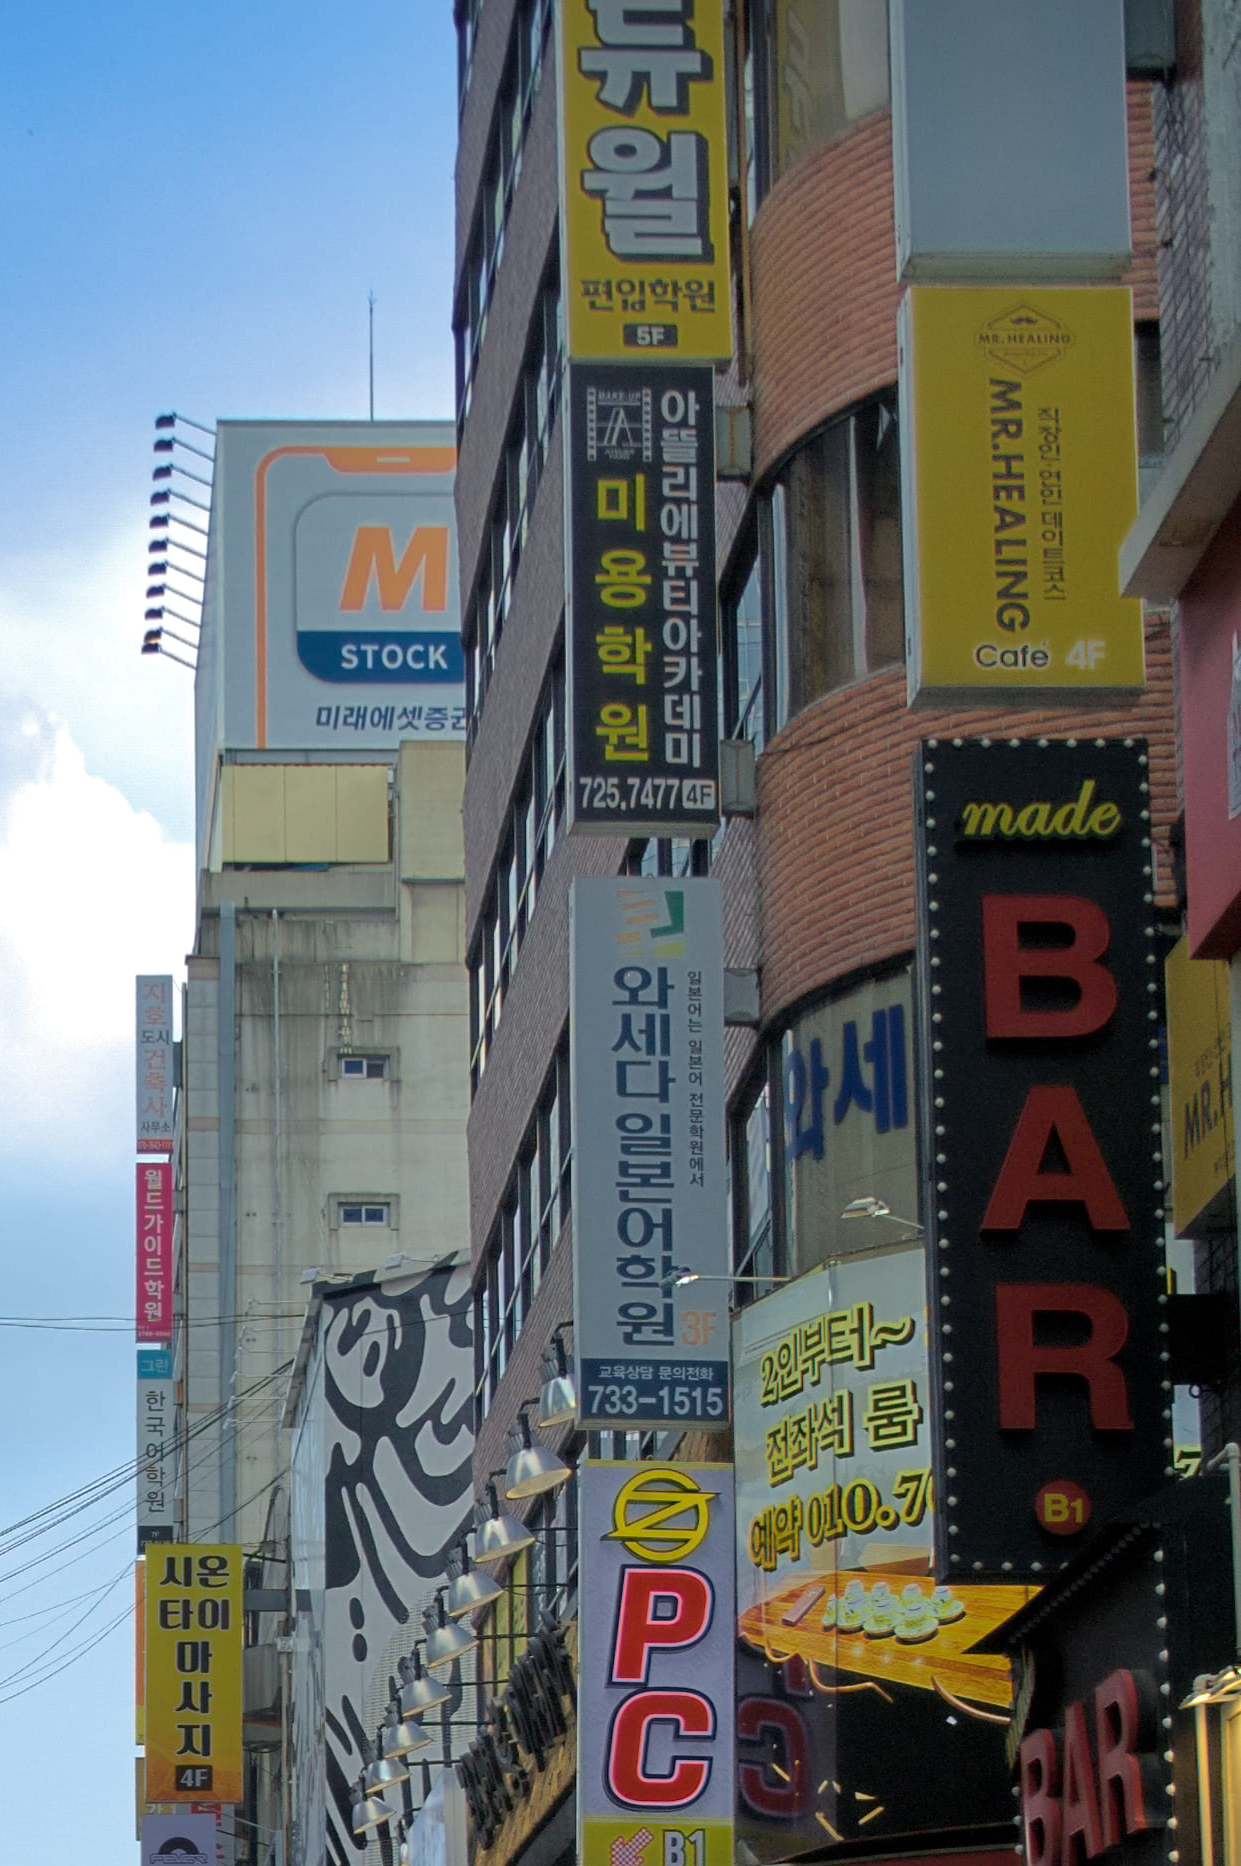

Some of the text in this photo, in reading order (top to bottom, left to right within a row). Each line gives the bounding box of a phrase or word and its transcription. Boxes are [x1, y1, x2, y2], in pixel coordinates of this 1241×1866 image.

[581, 279, 715, 313] 편입학원
[636, 326, 666, 346] 5F
[339, 525, 450, 613] M
[660, 389, 702, 768] 아뜰리에뷰티아카데미
[594, 472, 653, 763] 미용학원
[340, 644, 449, 670] STOCK
[1065, 640, 1106, 670] 4F
[579, 775, 680, 811] 725.7477
[961, 779, 1123, 837] made
[611, 965, 676, 1348] 와세다일본어학원
[980, 893, 1136, 1430] BAR
[143, 1168, 166, 1324] 월드가이드학원
[681, 1309, 718, 1347] 3F
[140, 1358, 170, 1375] 그린
[598, 1365, 715, 1384] 교육상담 문의전화
[587, 1383, 724, 1417] 733-1515
[863, 1378, 923, 1451] 룸
[143, 1390, 167, 1514] 한국어학원
[1042, 1493, 1084, 1524] B1
[158, 1554, 232, 1589] 시온
[158, 1597, 232, 1633] 타이
[174, 1639, 214, 1758] 마사지
[605, 1563, 718, 1812] PC
[180, 1767, 209, 1789] 4F
